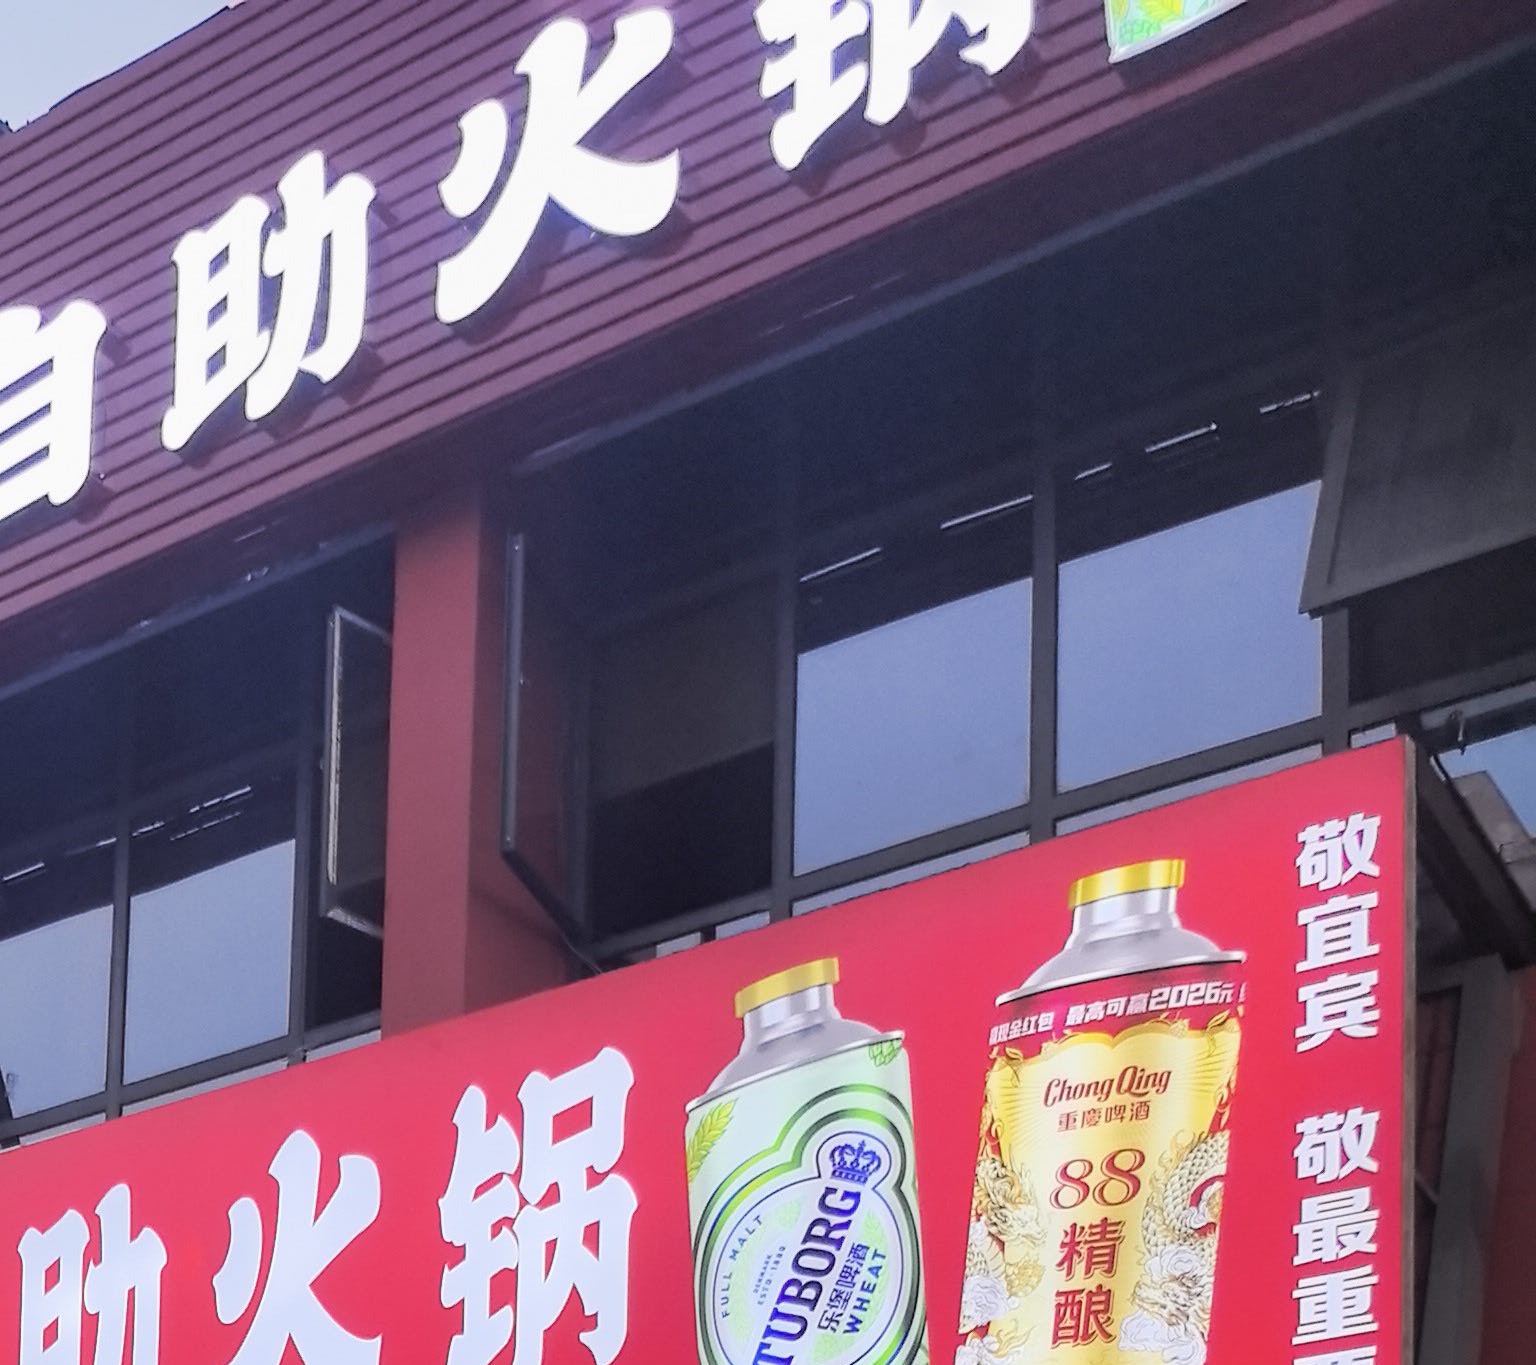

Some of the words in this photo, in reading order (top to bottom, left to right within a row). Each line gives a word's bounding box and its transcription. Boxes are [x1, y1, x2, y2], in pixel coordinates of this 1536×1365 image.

[1295, 812, 1381, 1053] 敬宜宾
[1050, 1149, 1145, 1209] 88
[817, 1243, 870, 1334] 乐堡啤酒
[843, 1248, 886, 1335] WHEAT
[1051, 1217, 1126, 1349] 精酿
